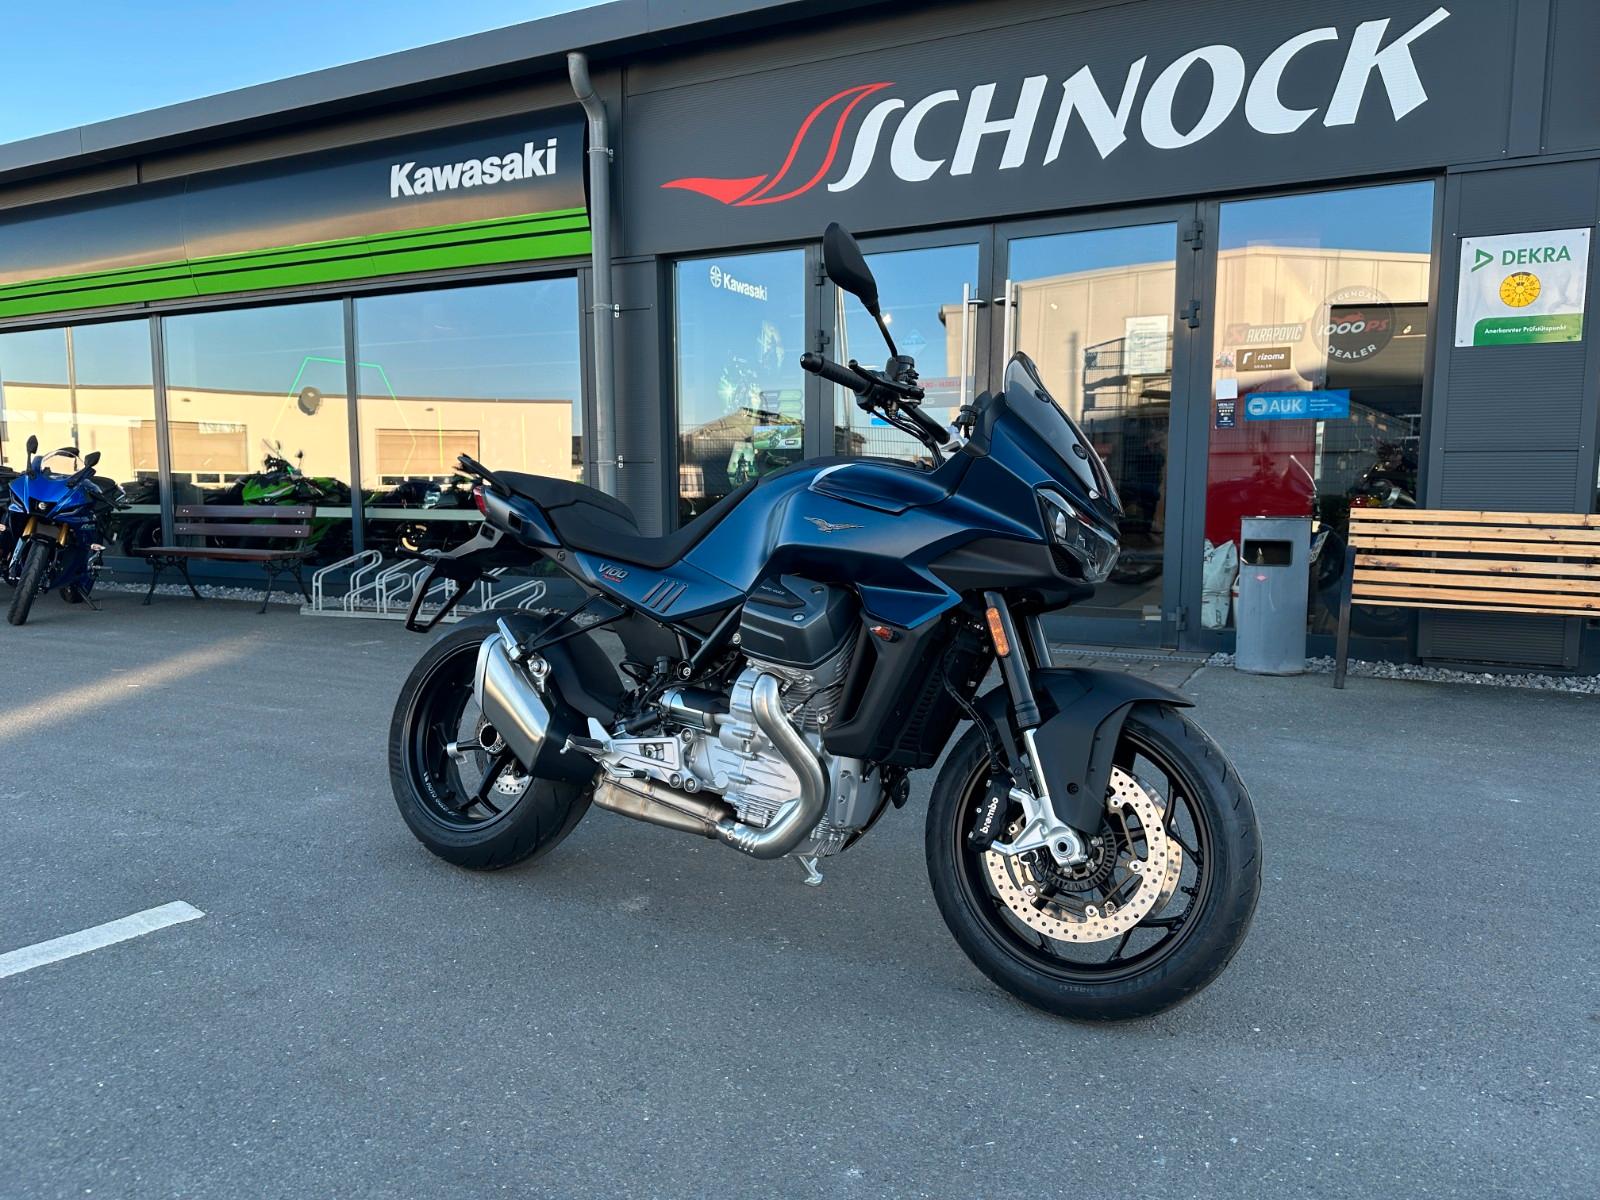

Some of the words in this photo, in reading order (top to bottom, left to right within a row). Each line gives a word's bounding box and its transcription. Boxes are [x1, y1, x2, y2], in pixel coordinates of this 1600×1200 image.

[828, 7, 1450, 194] SCHNOCK
[390, 138, 557, 199] Kawasaki
[1502, 246, 1571, 266] DEKRA
[723, 272, 768, 302] Kawasaki
[1317, 320, 1388, 337] 1000PS
[1257, 352, 1285, 361] rizoma
[1328, 344, 1377, 359] DEALER
[1268, 399, 1303, 413] AUK
[599, 562, 629, 579] V100
[979, 797, 999, 834] brembo
